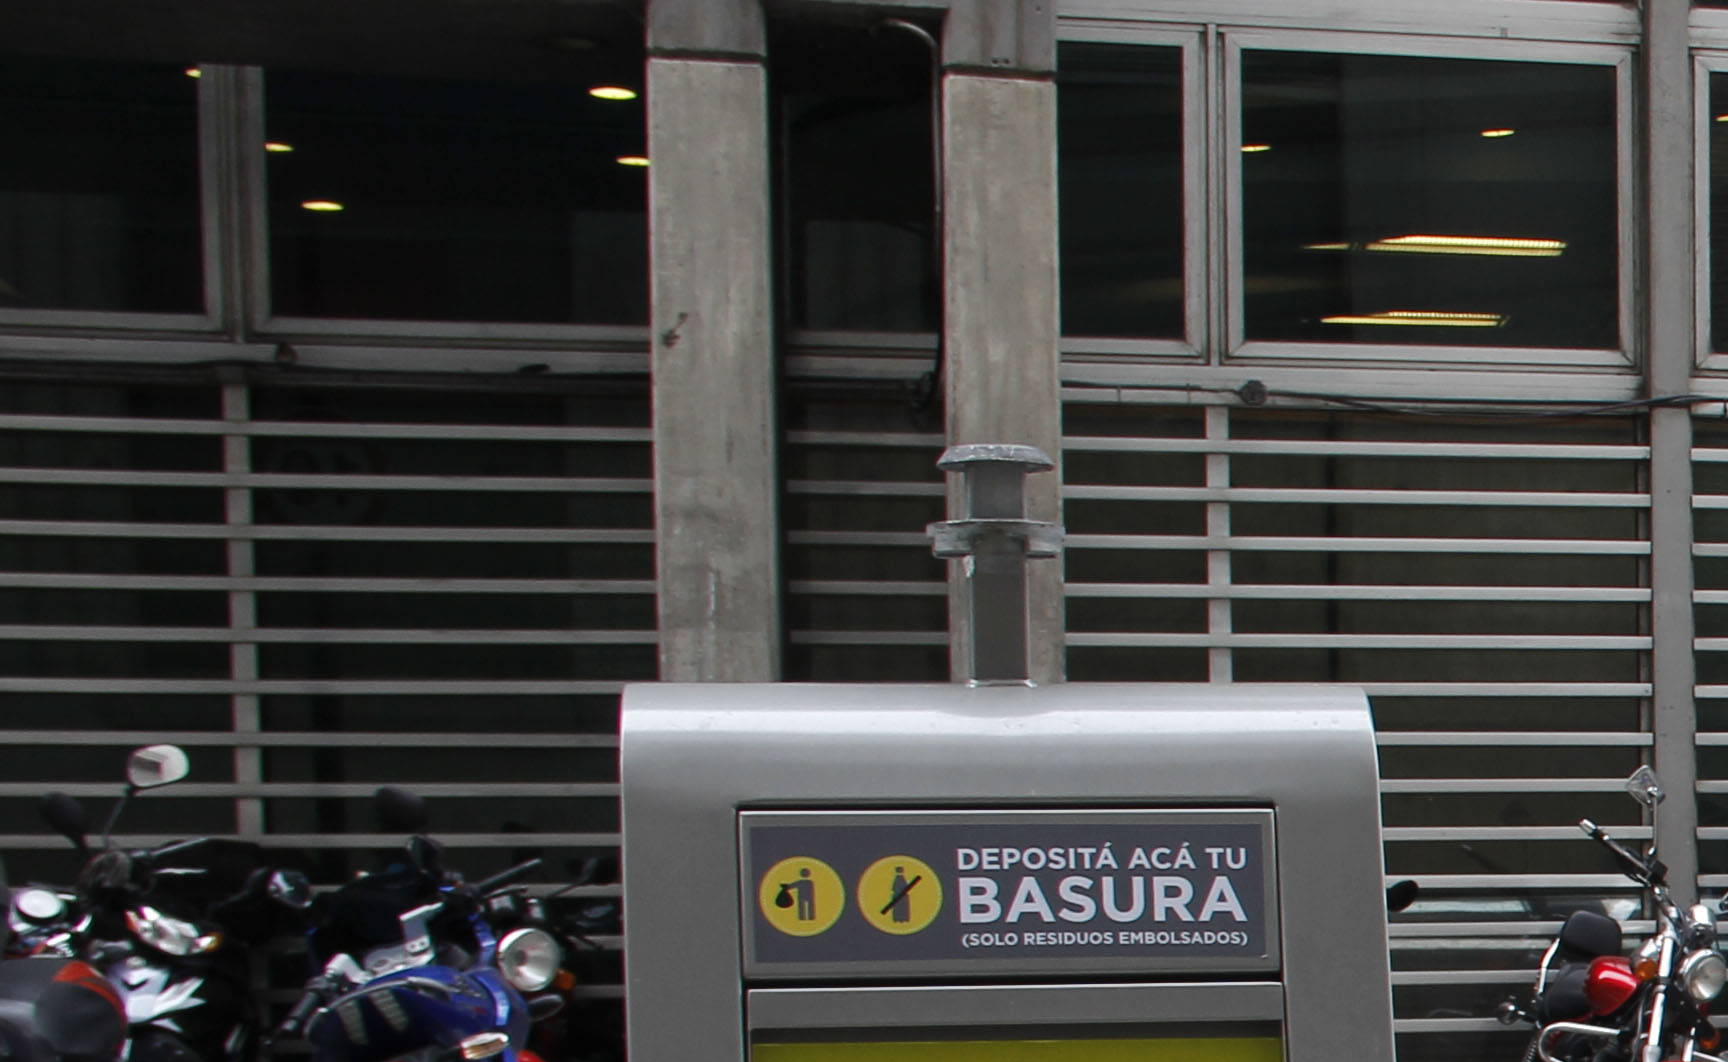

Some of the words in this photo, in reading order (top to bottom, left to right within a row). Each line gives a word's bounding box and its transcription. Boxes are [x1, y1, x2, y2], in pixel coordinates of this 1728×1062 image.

[957, 842, 1116, 870] DEPOSITÁ
[1128, 841, 1197, 870] ACÁ
[1206, 847, 1247, 869] TU
[959, 875, 1247, 924] BASURA
[962, 932, 1017, 948] (SOLO
[1024, 932, 1114, 946] RESIDUOS
[1119, 931, 1248, 948] EMBOLSADOS)
